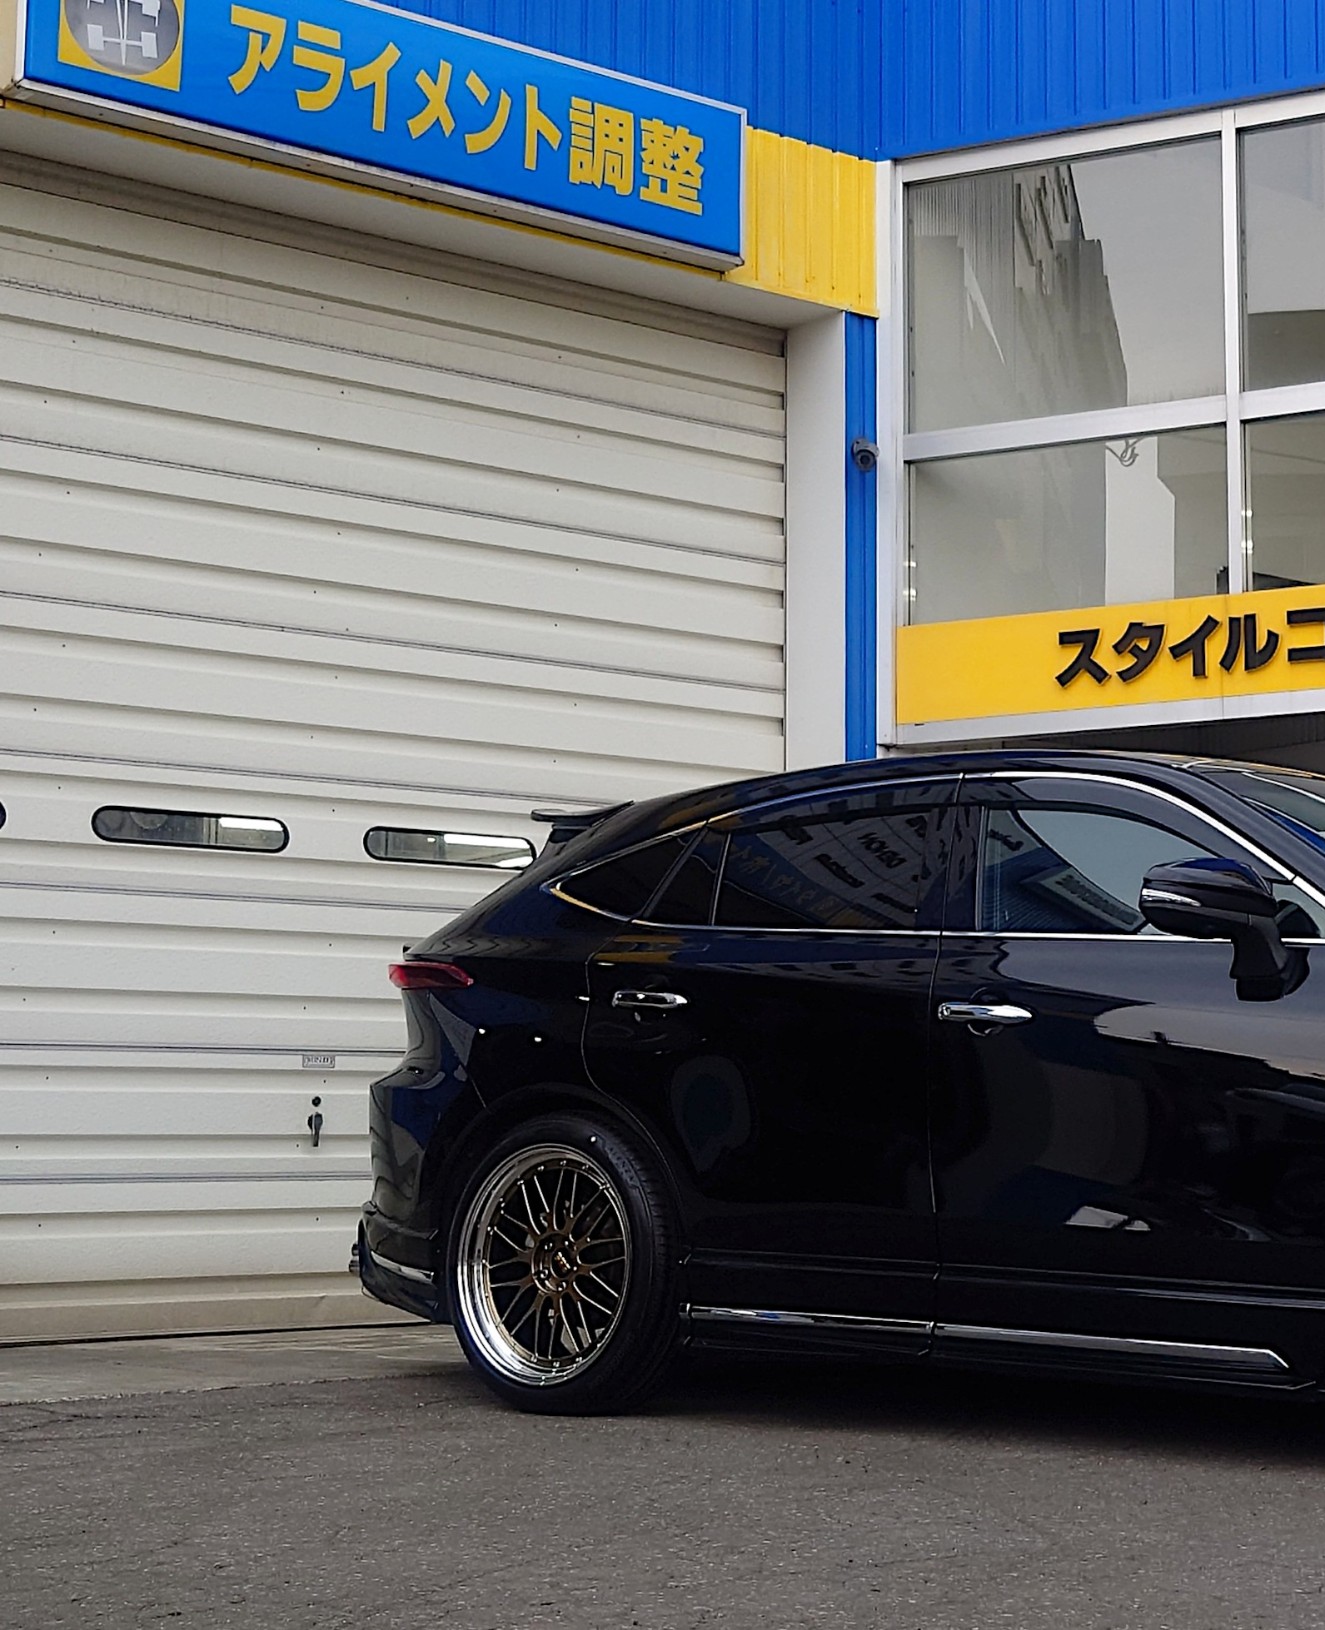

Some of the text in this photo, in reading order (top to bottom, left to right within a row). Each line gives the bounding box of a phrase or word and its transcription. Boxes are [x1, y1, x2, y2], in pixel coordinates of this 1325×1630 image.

[229, 6, 705, 217] アライメント調整
